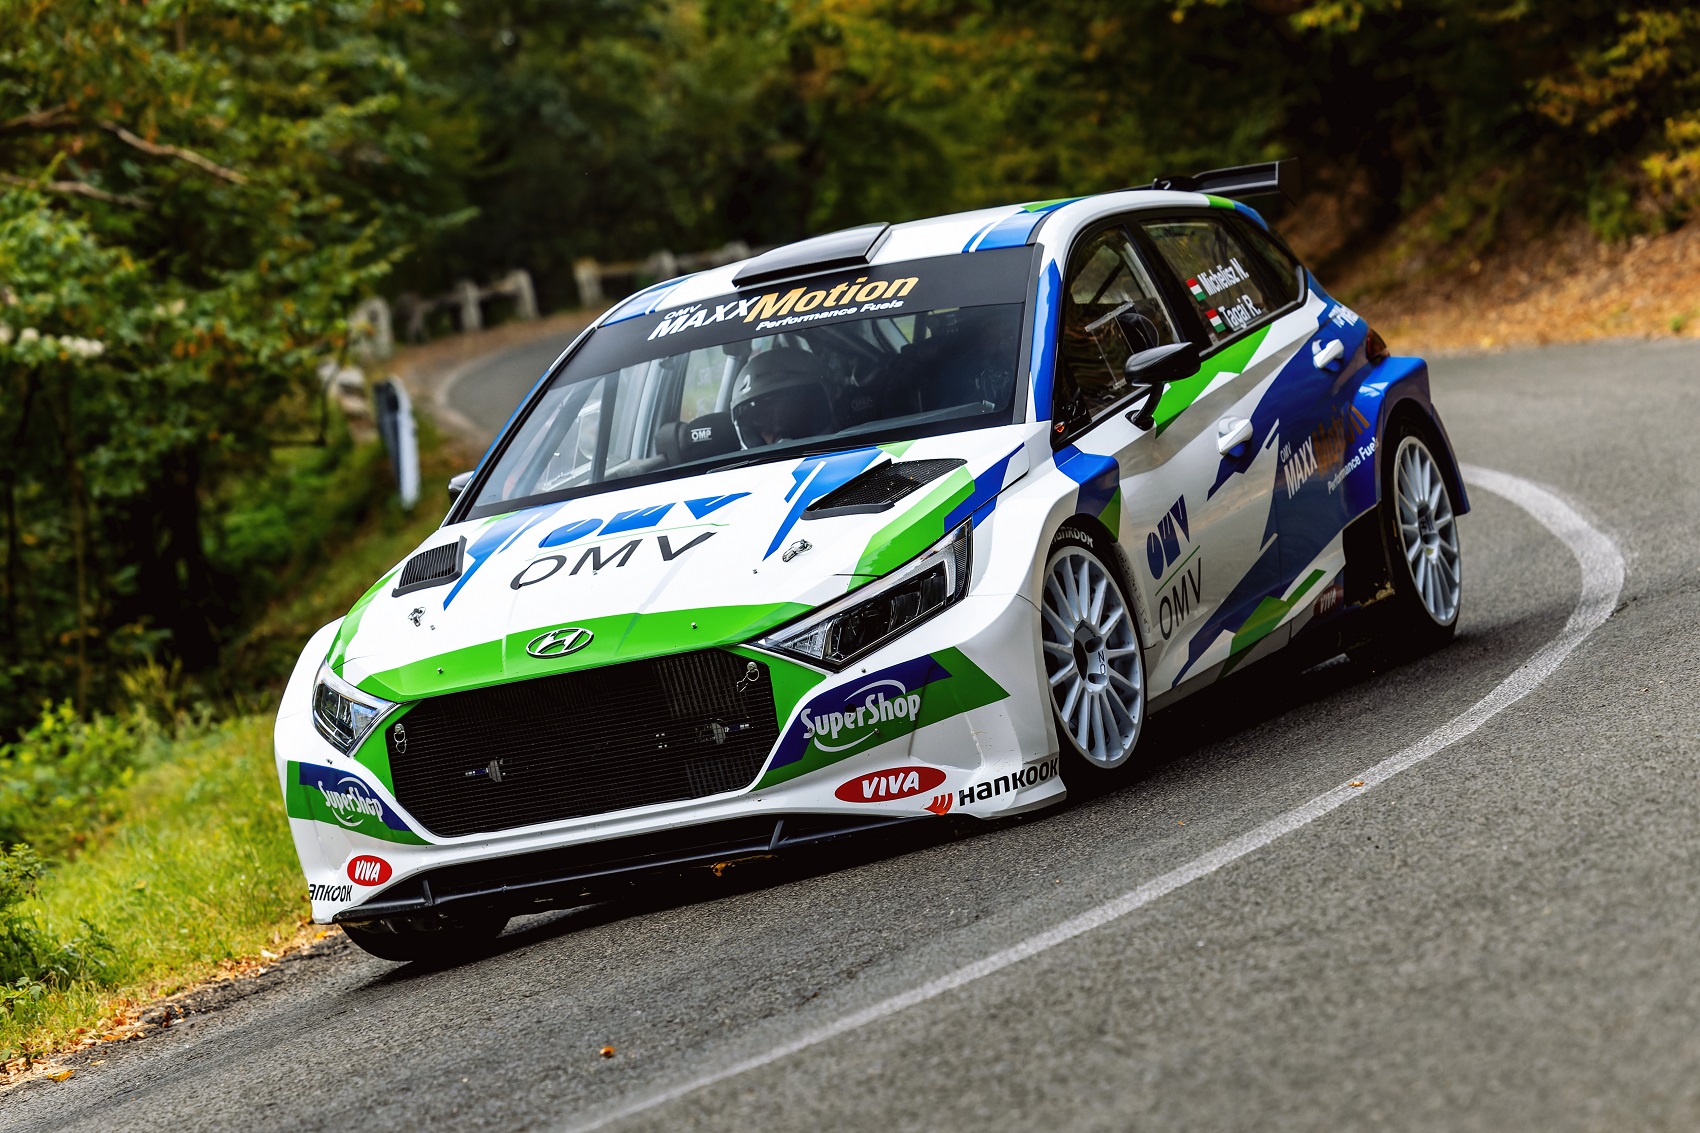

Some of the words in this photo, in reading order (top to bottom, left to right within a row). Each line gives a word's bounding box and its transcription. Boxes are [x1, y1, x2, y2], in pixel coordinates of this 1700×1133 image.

[1197, 264, 1241, 296] Michelisz
[1230, 257, 1249, 280] N.
[663, 304, 701, 319] OMV
[755, 306, 858, 332] Performance
[860, 299, 904, 313] Fuels
[1218, 297, 1251, 329] Tagai
[1241, 294, 1262, 317] R.
[691, 428, 712, 442] OMP
[1280, 441, 1292, 463] OMV
[1327, 455, 1361, 495] Performance
[510, 531, 718, 591] OMV
[1159, 557, 1202, 640] OMV
[1320, 588, 1337, 614] VIVA
[800, 692, 921, 739] SuperShop
[317, 781, 384, 822] SuperShop
[861, 771, 920, 799] VIVA
[354, 860, 381, 883] VIVA
